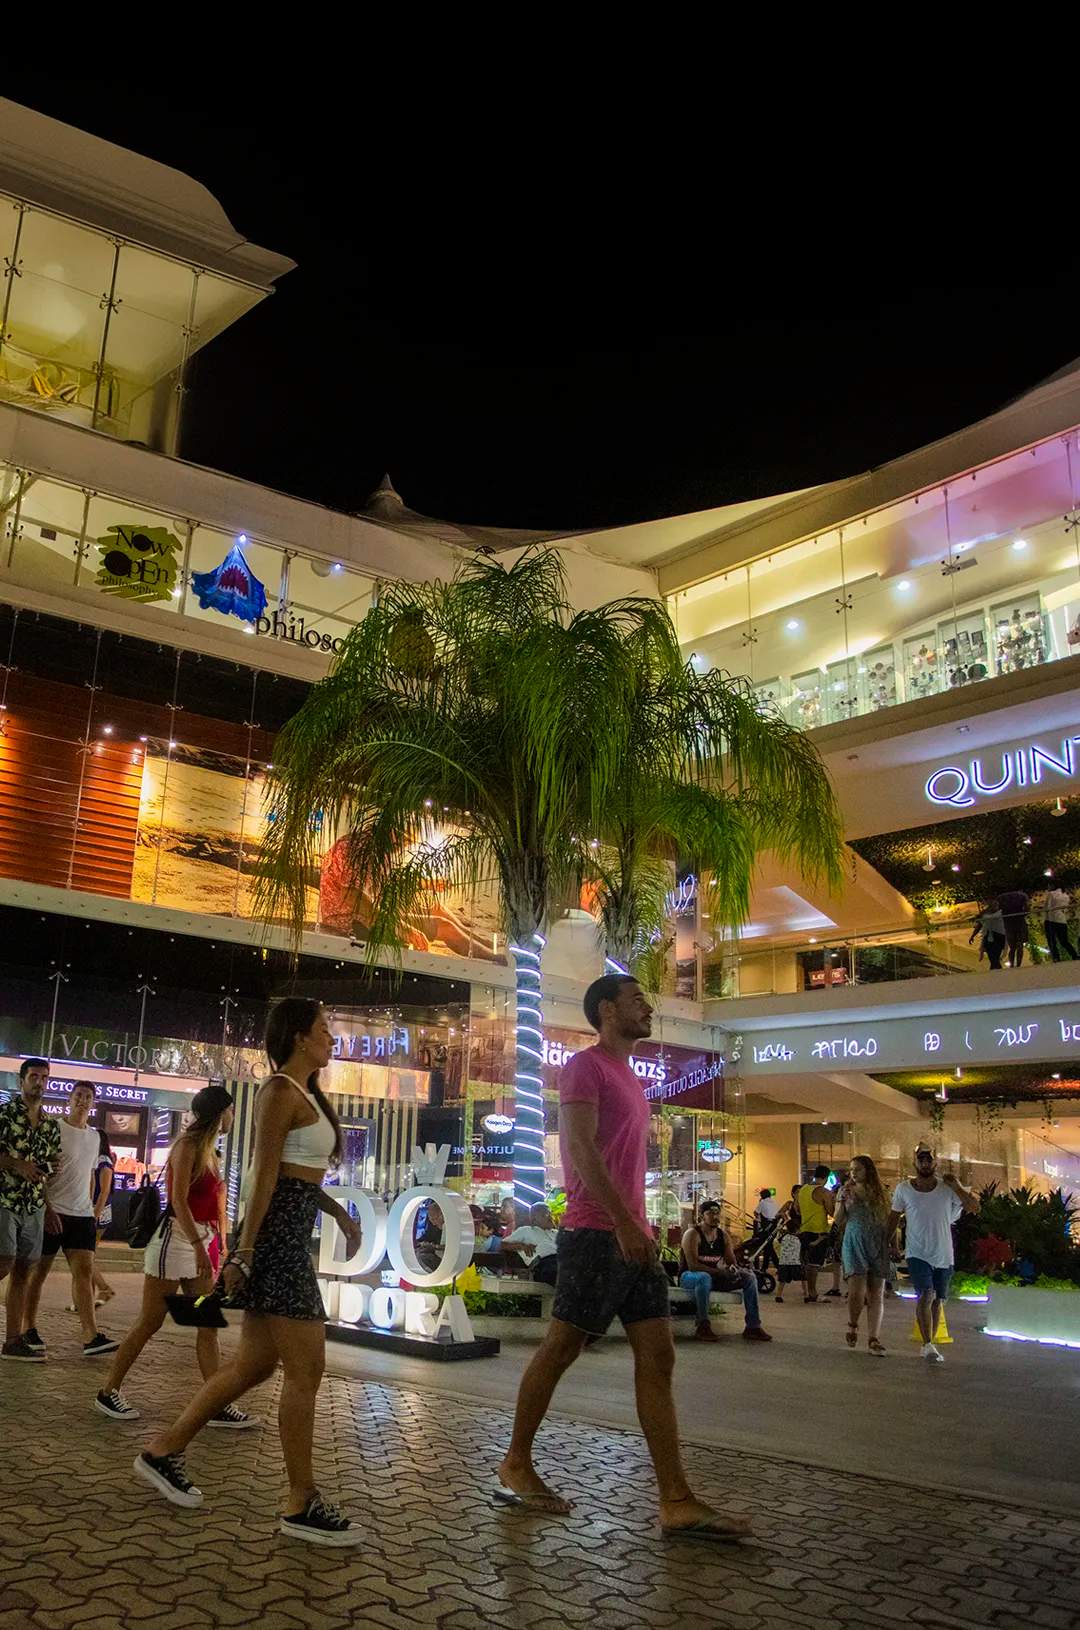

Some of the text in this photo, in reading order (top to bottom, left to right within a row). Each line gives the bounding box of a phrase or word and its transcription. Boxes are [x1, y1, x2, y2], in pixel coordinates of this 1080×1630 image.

[256, 610, 344, 655] philoso
[925, 733, 1080, 808] QUIN
[106, 1086, 148, 1101] SECRET
